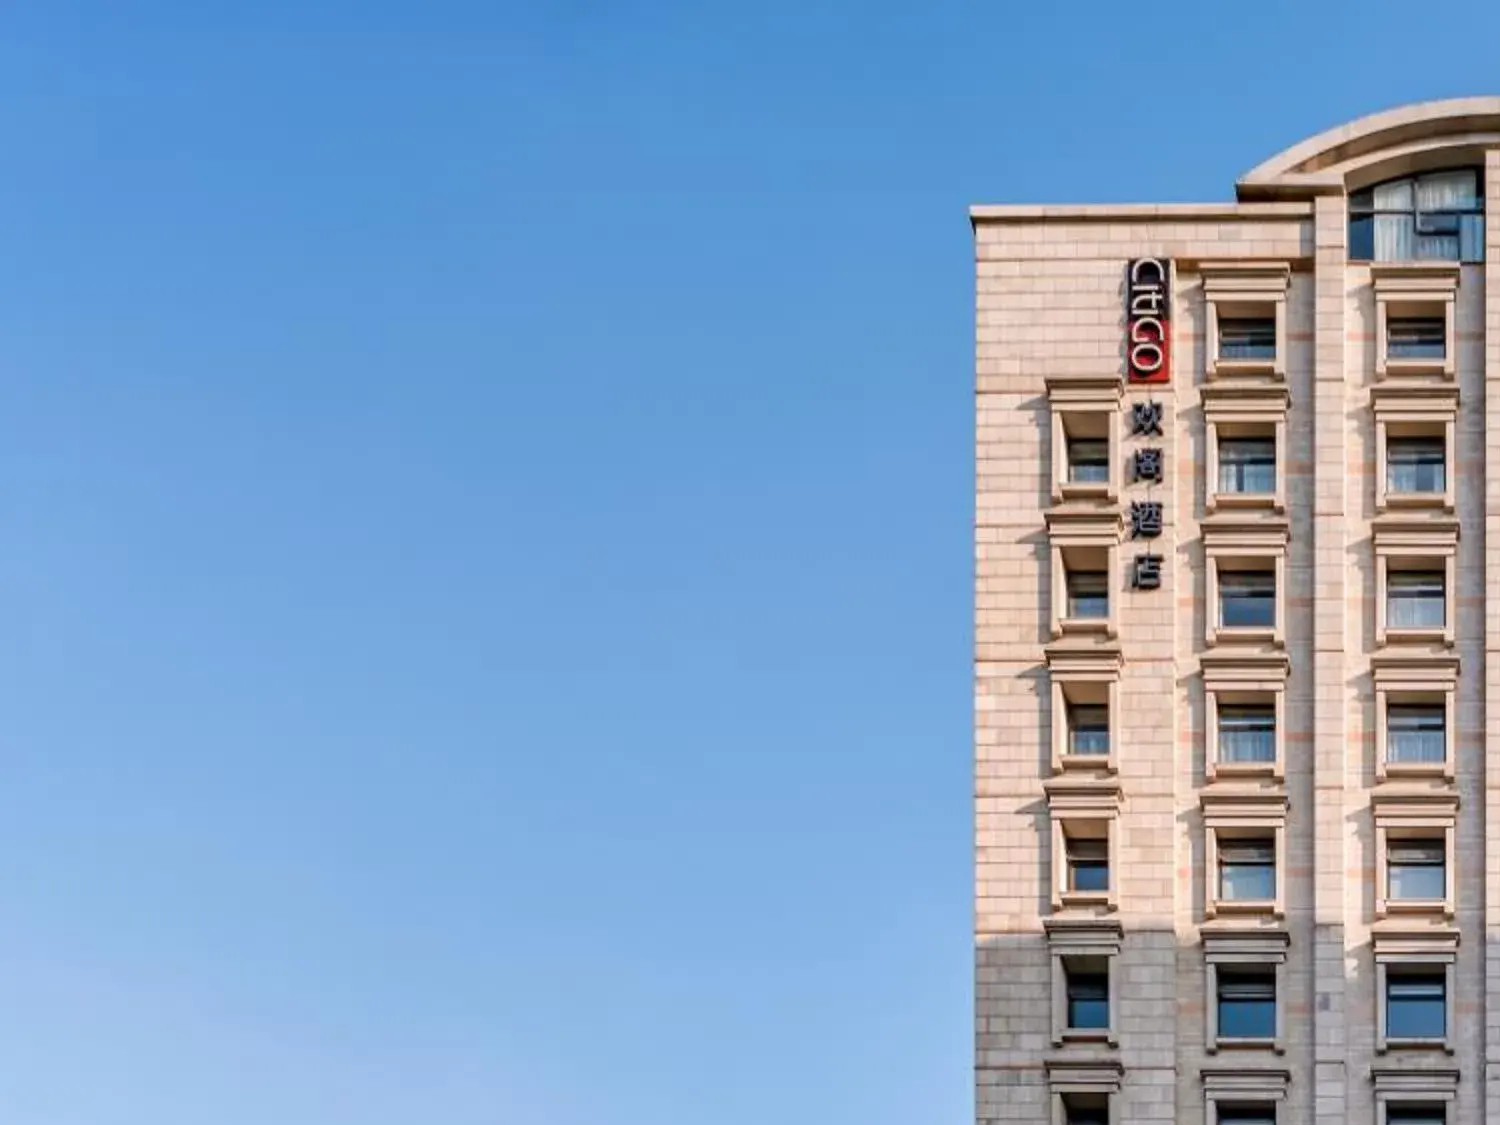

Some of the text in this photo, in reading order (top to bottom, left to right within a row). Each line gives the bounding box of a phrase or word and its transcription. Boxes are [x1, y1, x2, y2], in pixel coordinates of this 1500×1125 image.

[1131, 258, 1165, 371] CitiGO
[1131, 400, 1164, 589] 欢阁酒店
